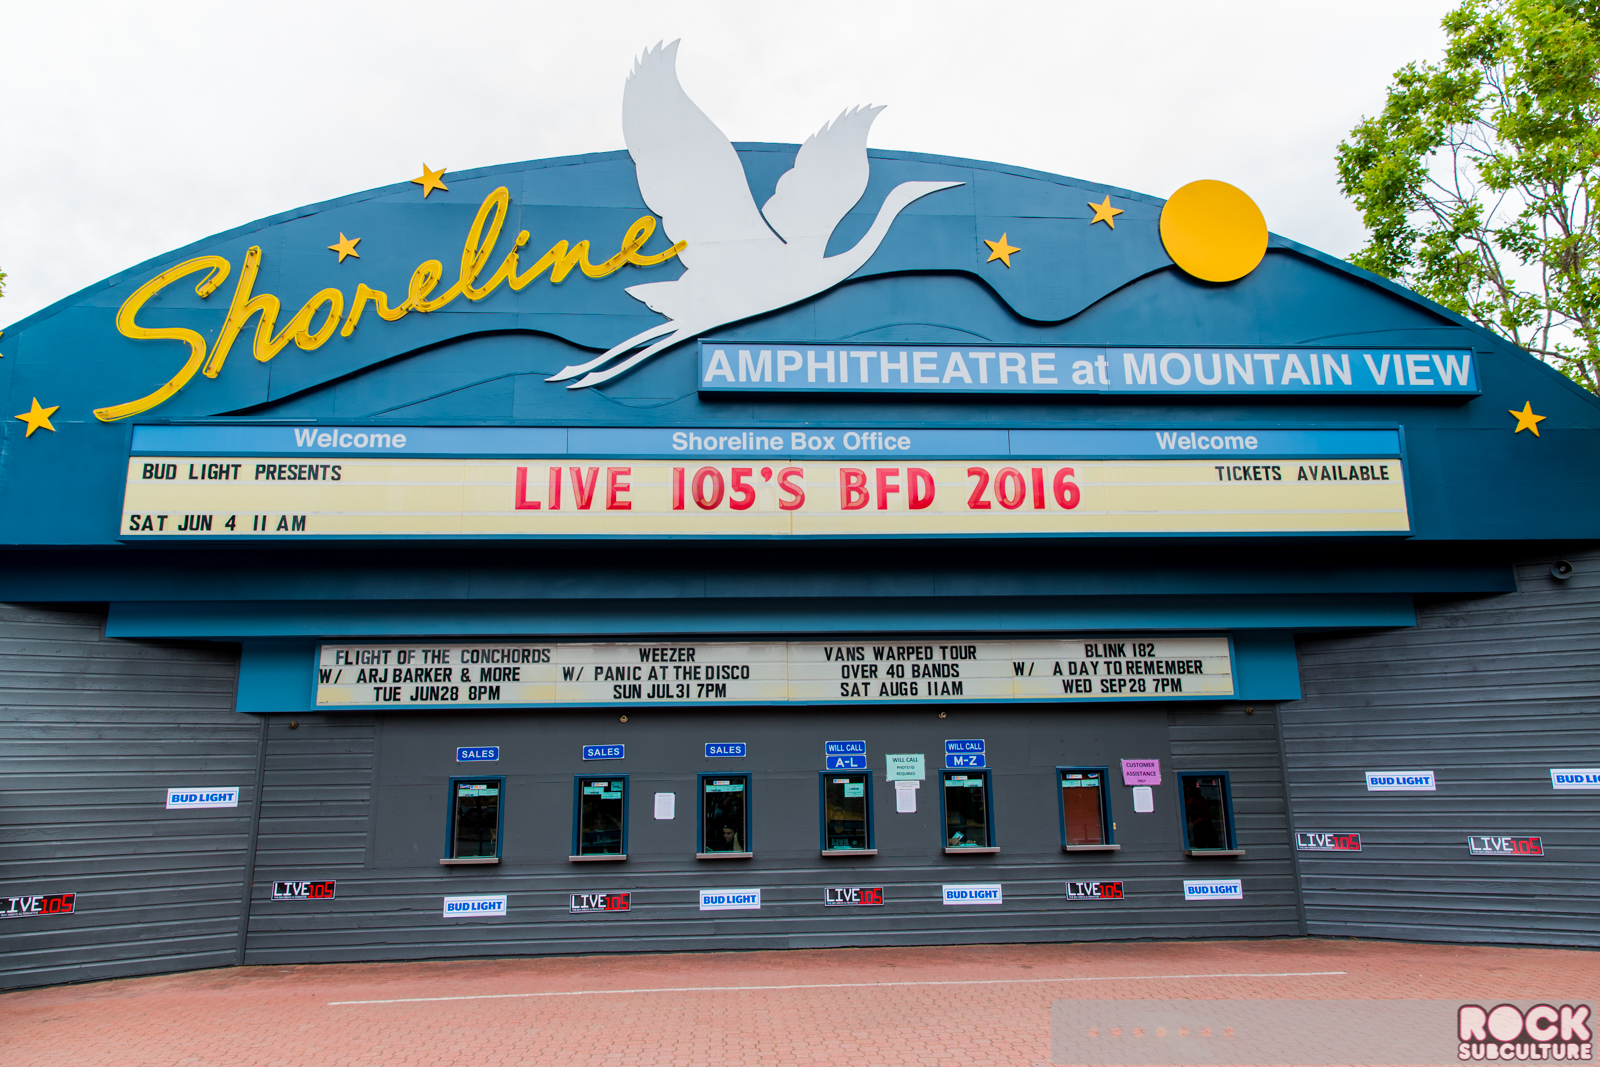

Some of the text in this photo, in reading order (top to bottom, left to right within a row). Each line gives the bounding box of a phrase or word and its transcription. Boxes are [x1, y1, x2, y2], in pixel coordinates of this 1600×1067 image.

[93, 186, 687, 422] Shoreline
[703, 349, 1470, 386] AMPHITHEATRE at MOUNTAIN VIEW
[294, 428, 407, 448] Welcome
[672, 431, 911, 450] Shoreline Box Office
[1155, 431, 1258, 450] Welcome
[142, 463, 342, 481] BUD LIGHT PRESENTS
[1215, 465, 1390, 481] TICKETS AVAILABLE
[514, 465, 1081, 511] LIVE 105'S BFD 2016
[129, 514, 168, 532] SAT
[178, 514, 213, 531] JUN
[224, 514, 236, 531] 4
[276, 514, 306, 531] AM
[335, 648, 551, 666] FLIGHT OF THE CONCHORDS
[639, 647, 696, 662] WEEZER
[824, 645, 977, 662] VANS WARPED TOUR
[1085, 643, 1156, 658] BLINK 182
[356, 668, 388, 684] ARJ
[392, 667, 452, 683] BARKER
[460, 667, 472, 682] &
[480, 667, 521, 682] MORE
[594, 666, 642, 681] PANIC
[648, 666, 669, 680] AT
[673, 665, 702, 680] THE
[705, 665, 750, 680] DISCO
[841, 663, 960, 679] OVER 40 BANDS
[1053, 661, 1063, 676] A
[1068, 661, 1099, 676] DAY
[1104, 661, 1123, 675] TO
[1126, 660, 1204, 675] REMEMBER
[374, 686, 401, 702] TUE
[468, 685, 501, 701] 8PM
[613, 684, 642, 699] SUN
[697, 683, 727, 698] 7PM
[840, 682, 870, 697] SAT
[1062, 679, 1092, 694] WED
[1152, 678, 1183, 693] 7PM
[461, 750, 495, 759] SALES
[587, 748, 620, 757] SALES
[710, 746, 742, 754] SALES
[828, 744, 844, 752] WILL
[835, 757, 858, 767] A-L
[953, 756, 978, 766] M-Z
[1370, 776, 1430, 785] BUD LIGHT
[1556, 774, 1584, 783] BUD
[171, 793, 234, 803] BUD LIGHT
[947, 890, 998, 899] BUD LIGHT
[1188, 885, 1238, 894] BUD LIGHT
[447, 901, 502, 911] BUD LIGHT
[703, 895, 756, 904] BUD LIGHT
